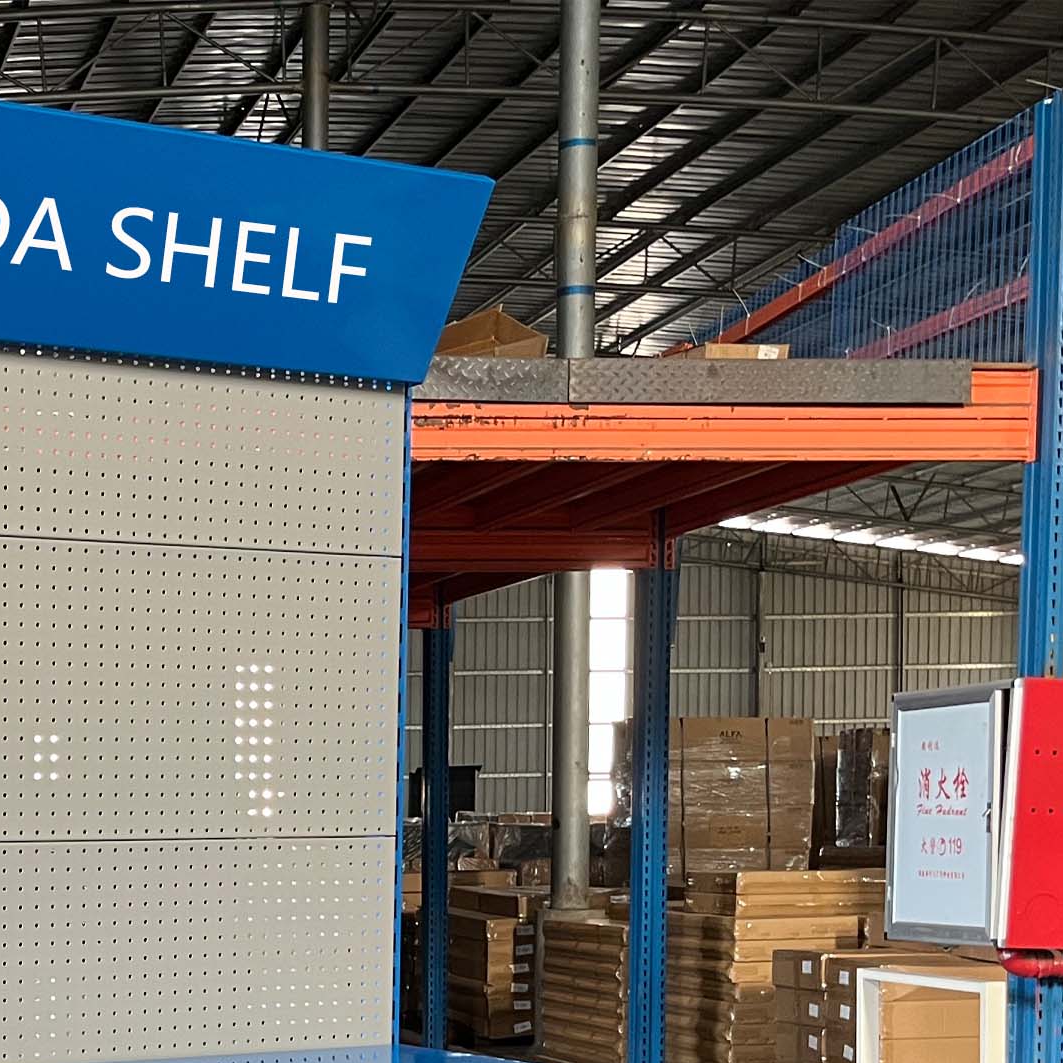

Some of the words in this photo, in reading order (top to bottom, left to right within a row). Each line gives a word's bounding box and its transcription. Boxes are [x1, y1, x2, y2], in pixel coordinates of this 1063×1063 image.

[105, 206, 373, 304] SHELF
[918, 766, 969, 800] 消火栓
[948, 837, 962, 855] 119
